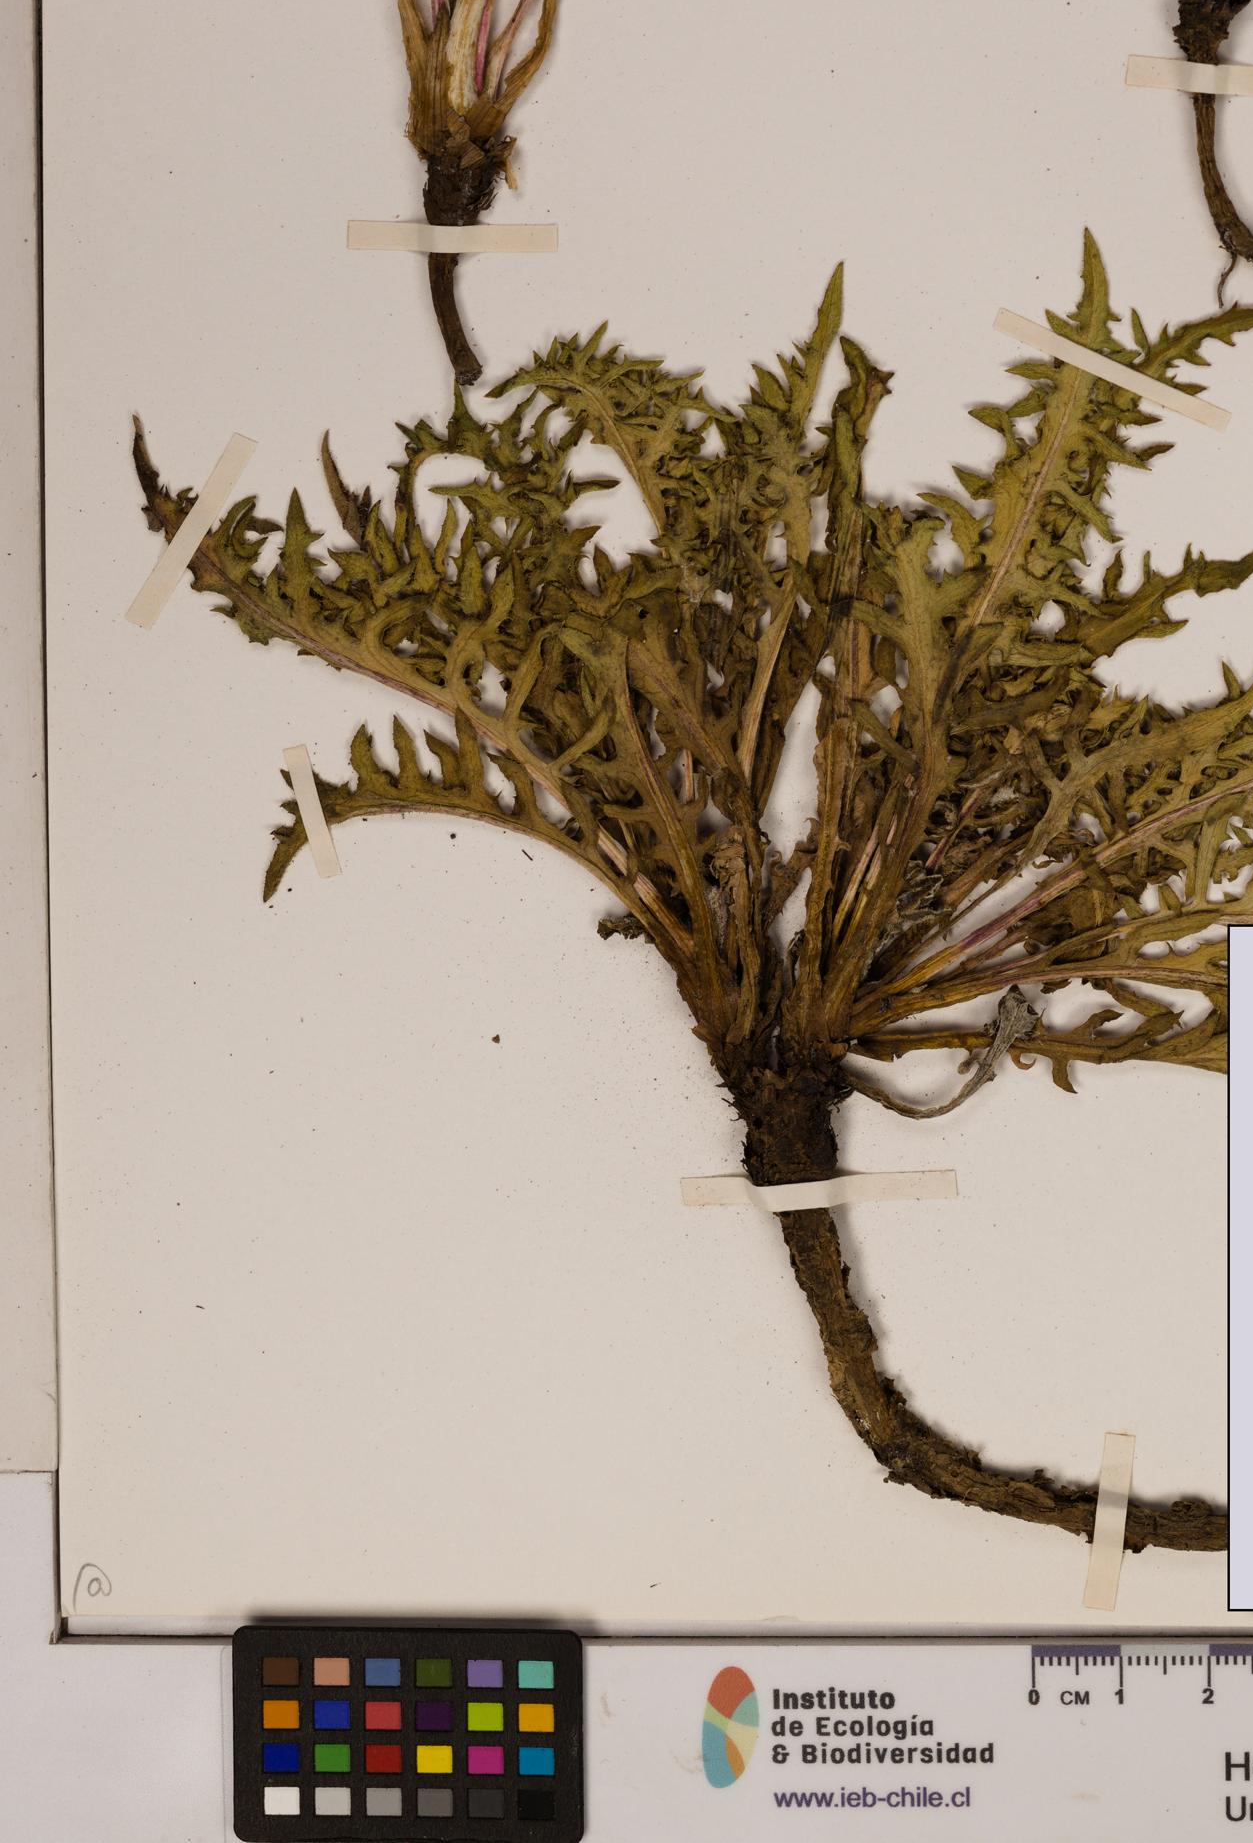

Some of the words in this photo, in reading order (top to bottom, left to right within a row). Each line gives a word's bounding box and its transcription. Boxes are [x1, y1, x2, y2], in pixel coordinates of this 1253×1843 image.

[772, 1686, 896, 1710] Instituto
[1028, 1688, 1041, 1706] 0
[1059, 1690, 1090, 1706] CM
[1114, 1687, 1125, 1705] 1
[1201, 1687, 1215, 1705] 2
[770, 1715, 804, 1737] de
[815, 1714, 934, 1741] Ecología
[771, 1743, 790, 1765] &
[801, 1741, 994, 1765] Biodiversidad
[773, 1786, 971, 1808] www.ieb-chile.cl
